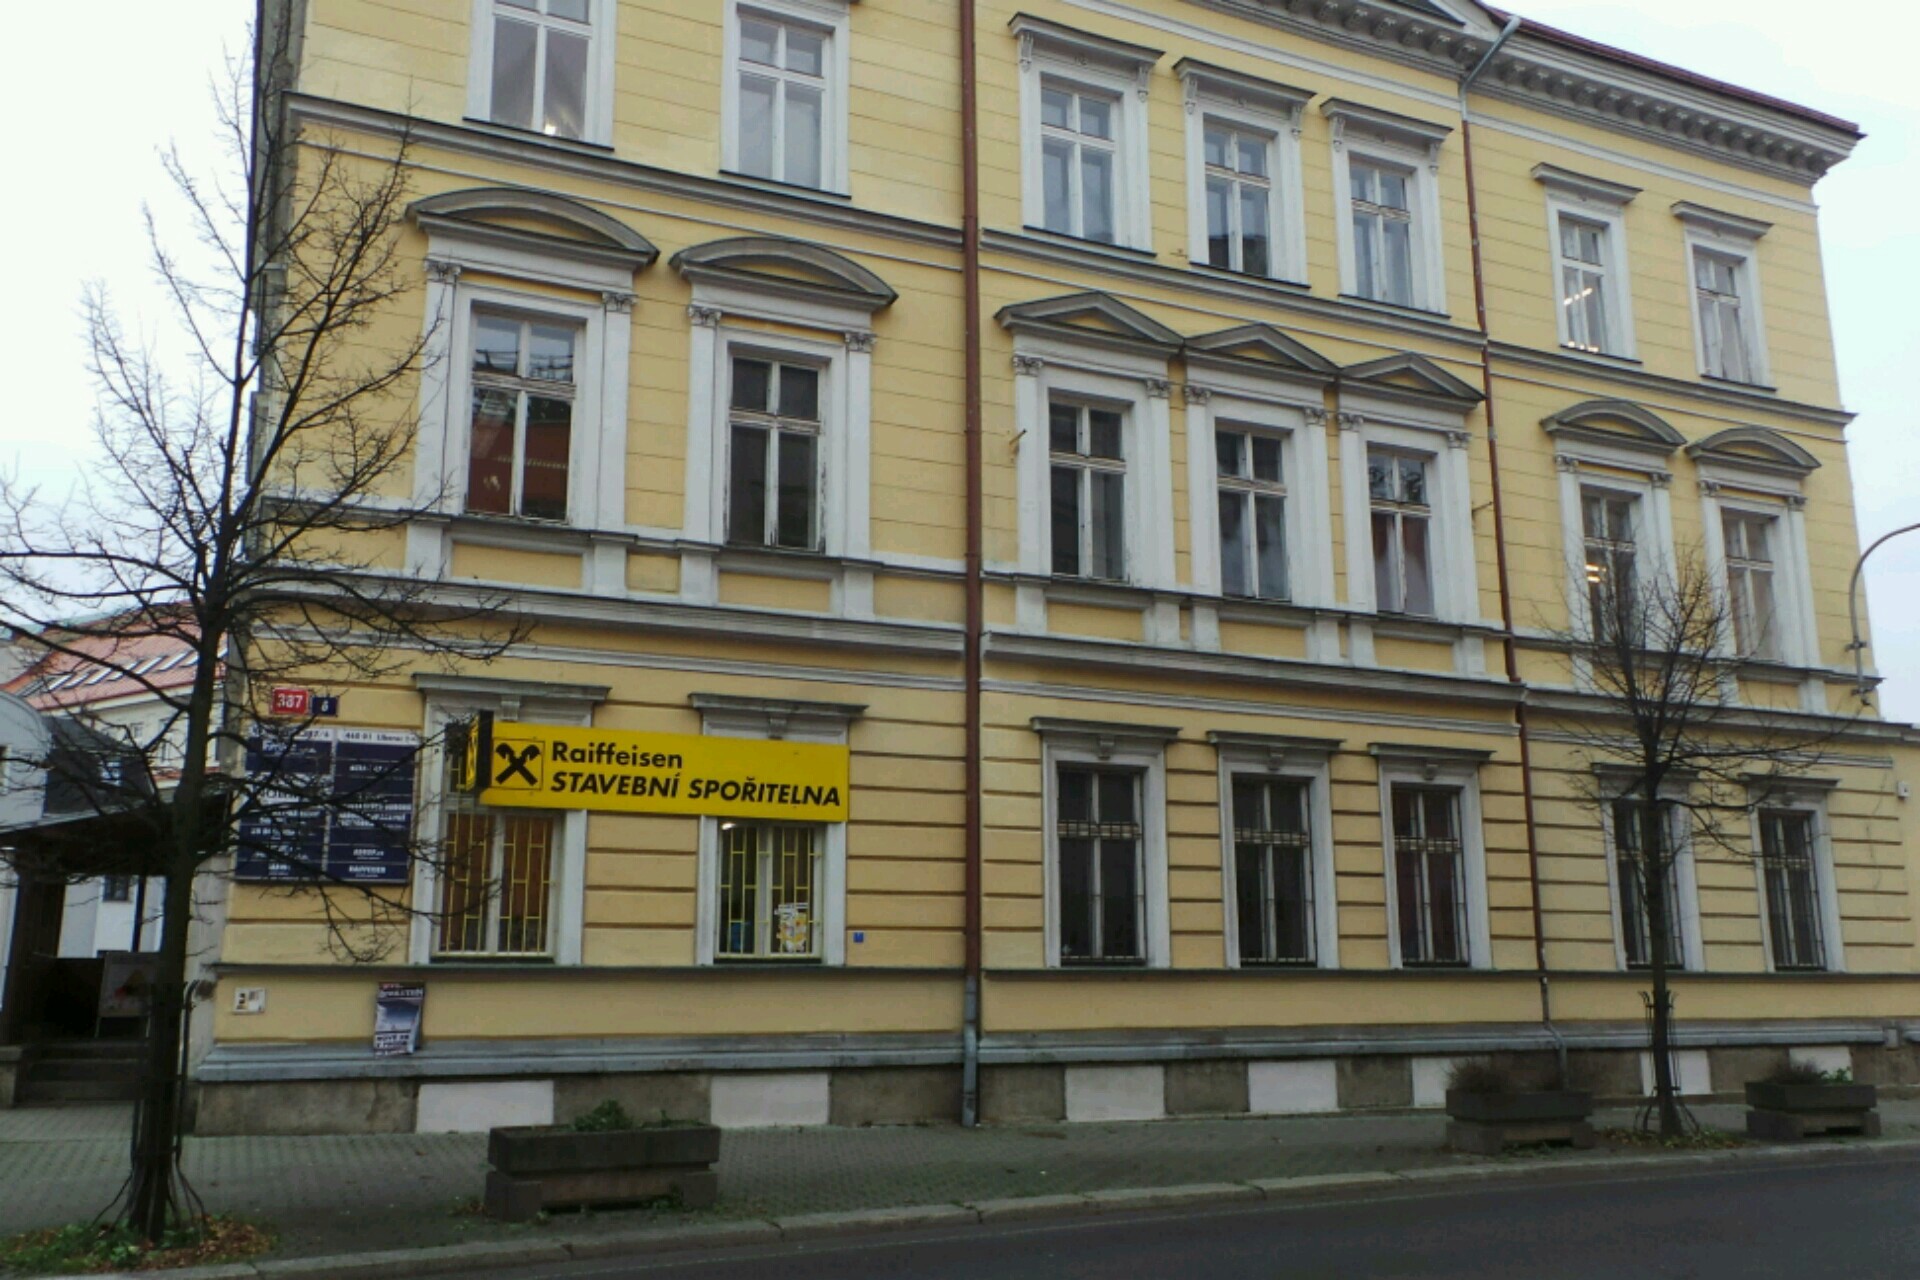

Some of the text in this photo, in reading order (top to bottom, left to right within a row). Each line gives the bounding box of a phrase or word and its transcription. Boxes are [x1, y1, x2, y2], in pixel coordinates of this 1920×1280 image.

[278, 693, 303, 709] 387
[552, 741, 683, 769] Raiffeisen
[550, 771, 841, 807] STAVEBNÍ SPOŘITELNA
